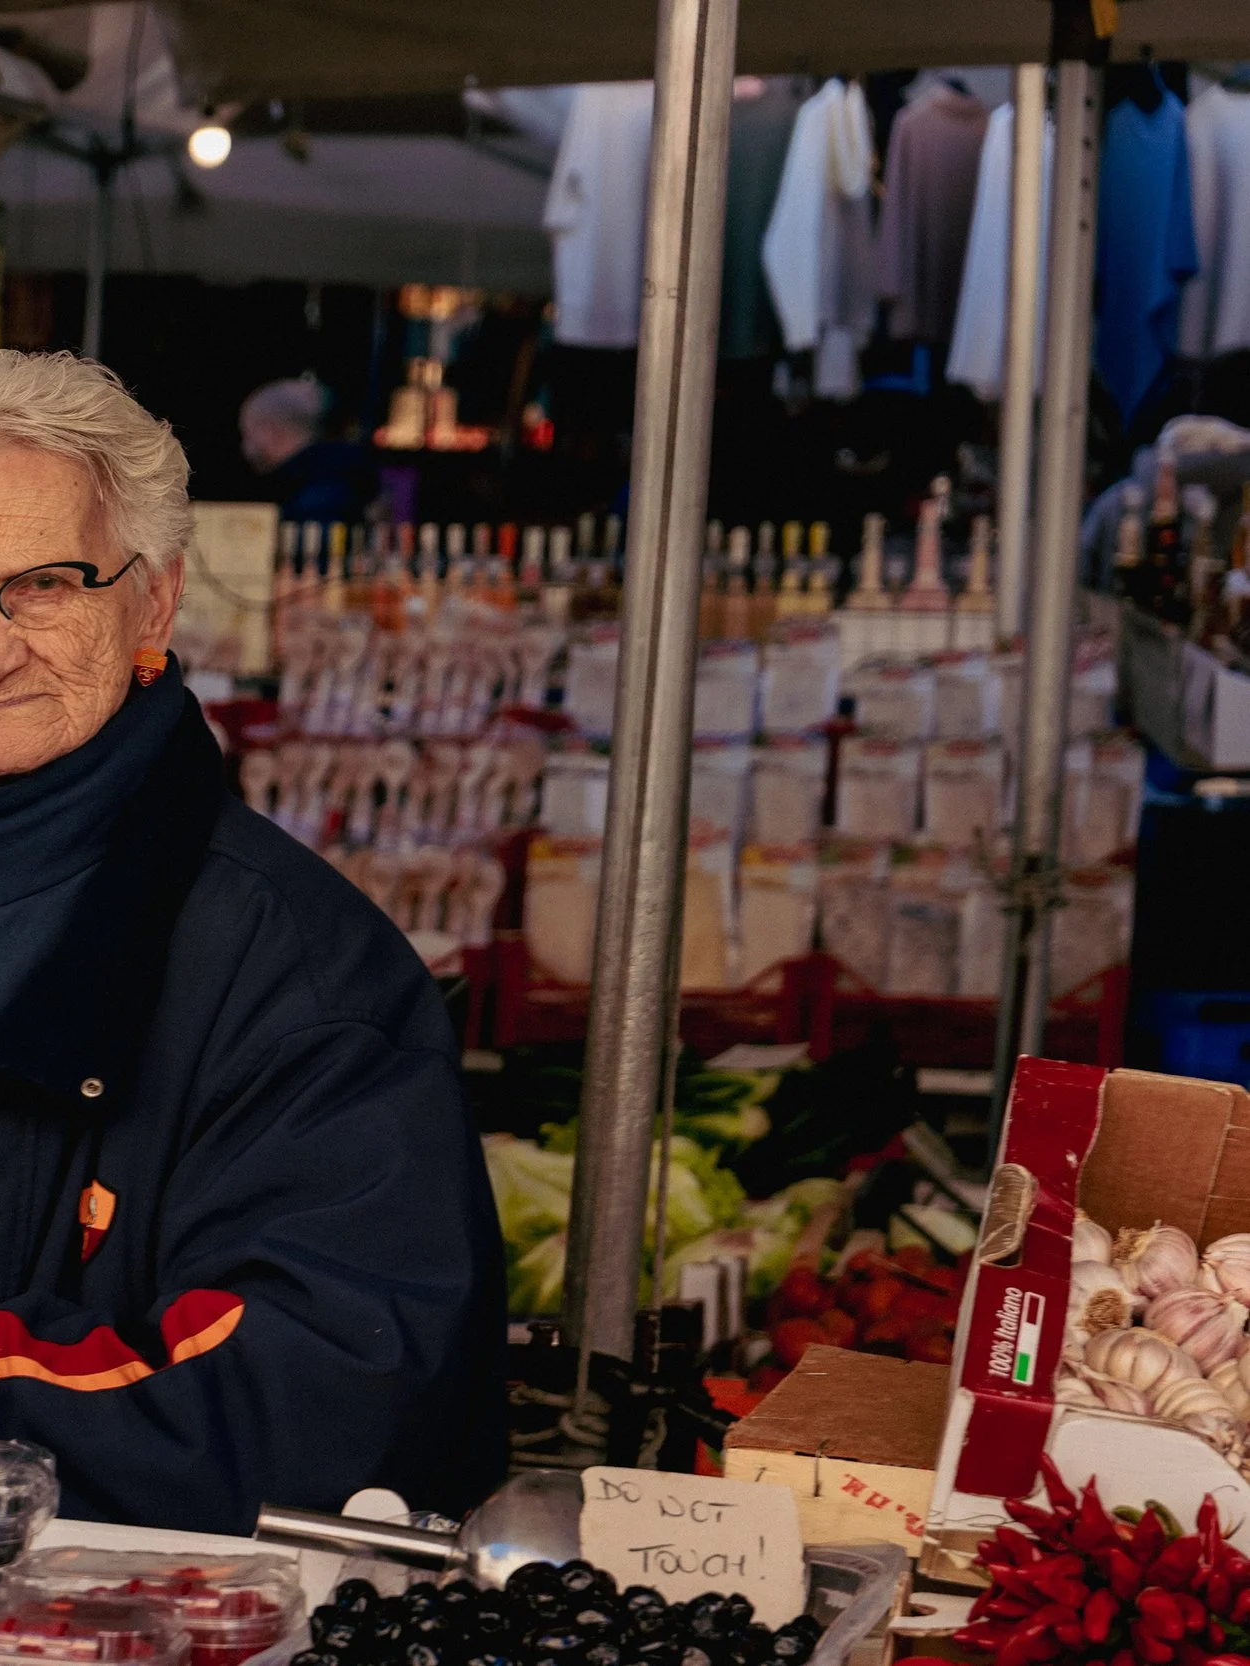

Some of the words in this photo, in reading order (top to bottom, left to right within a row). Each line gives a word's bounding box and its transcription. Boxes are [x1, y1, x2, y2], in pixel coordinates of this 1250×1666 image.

[993, 1286, 1024, 1341] Italiano
[987, 1339, 1015, 1378] 100%
[597, 1478, 644, 1504] DO
[659, 1495, 737, 1523] NOT
[628, 1535, 766, 1581] TOUCH!
